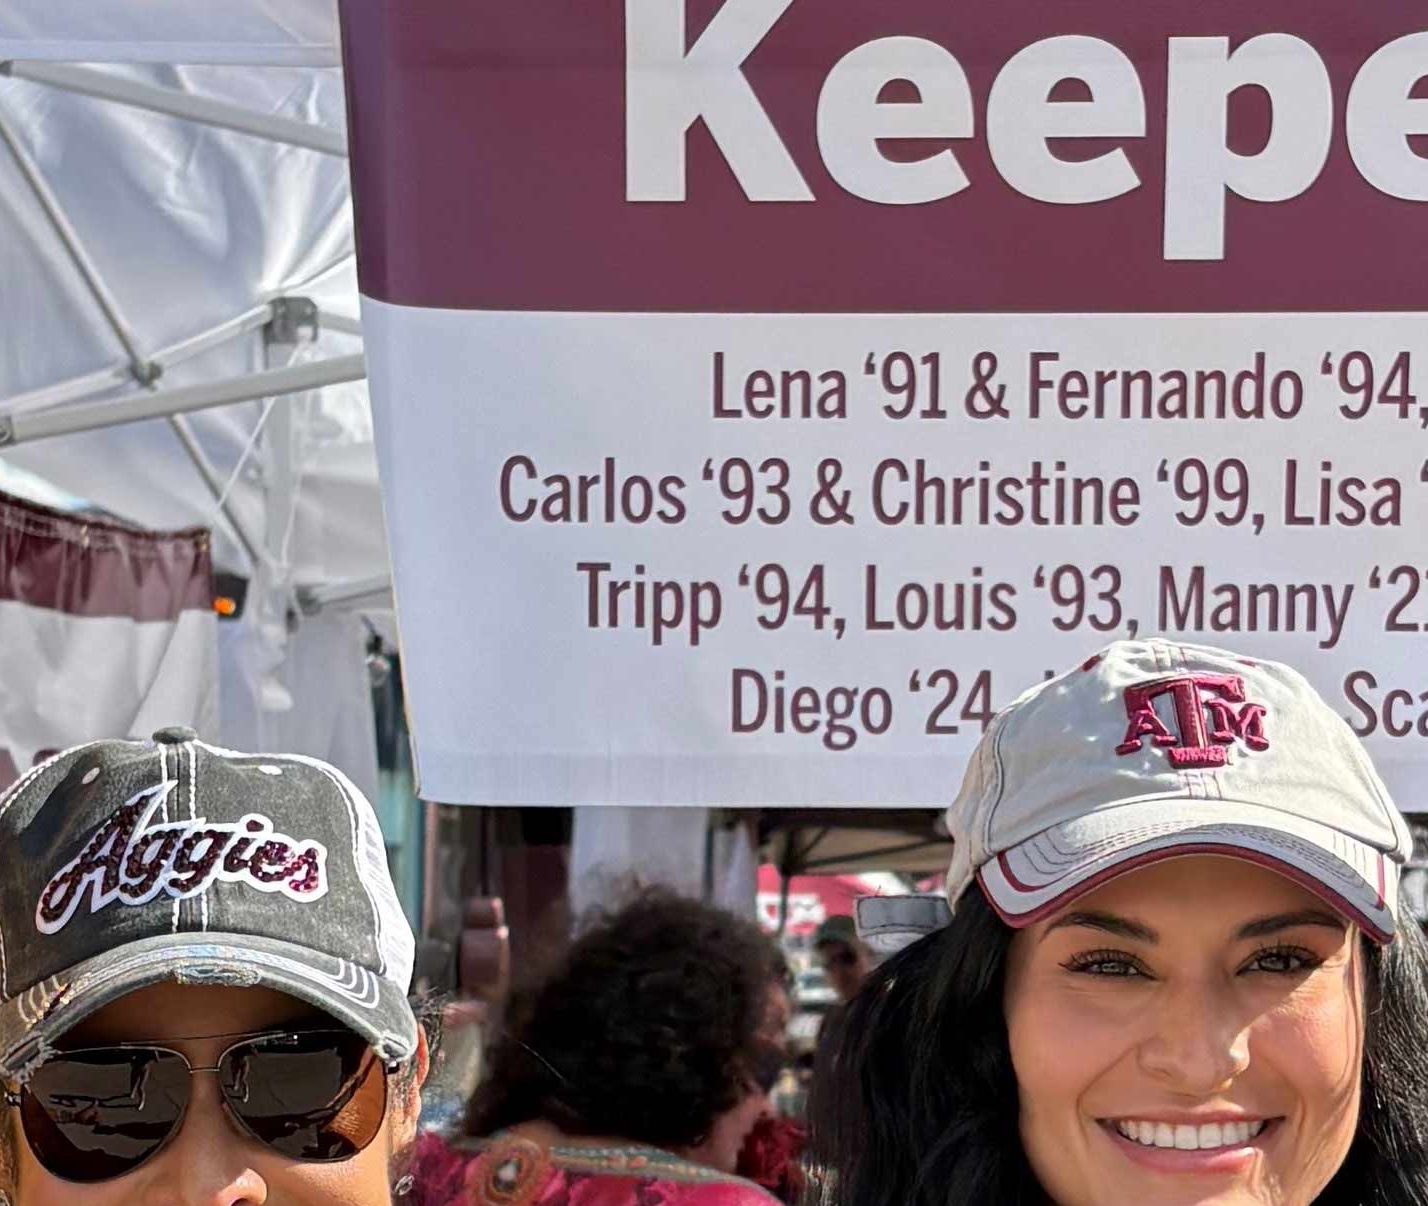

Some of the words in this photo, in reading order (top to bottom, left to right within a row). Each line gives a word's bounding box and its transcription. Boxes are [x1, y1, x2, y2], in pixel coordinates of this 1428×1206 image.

[714, 352, 846, 419] Lena
[865, 352, 946, 420] ‘91
[965, 352, 1009, 420] &
[1030, 352, 1303, 420] Fernando
[500, 455, 686, 524] Carlos
[703, 457, 790, 525] ‘93
[810, 457, 854, 525] &
[873, 457, 1140, 526] Christine
[1158, 458, 1264, 536] ‘99,
[1286, 459, 1401, 527] Lisa
[577, 562, 721, 647] Tripp
[739, 563, 845, 640] ‘94,
[866, 564, 1016, 631] Louis
[1034, 564, 1138, 641] ‘93,
[1159, 565, 1354, 650] Manny
[732, 669, 892, 751] Diego
[37, 782, 327, 932] Aggies
